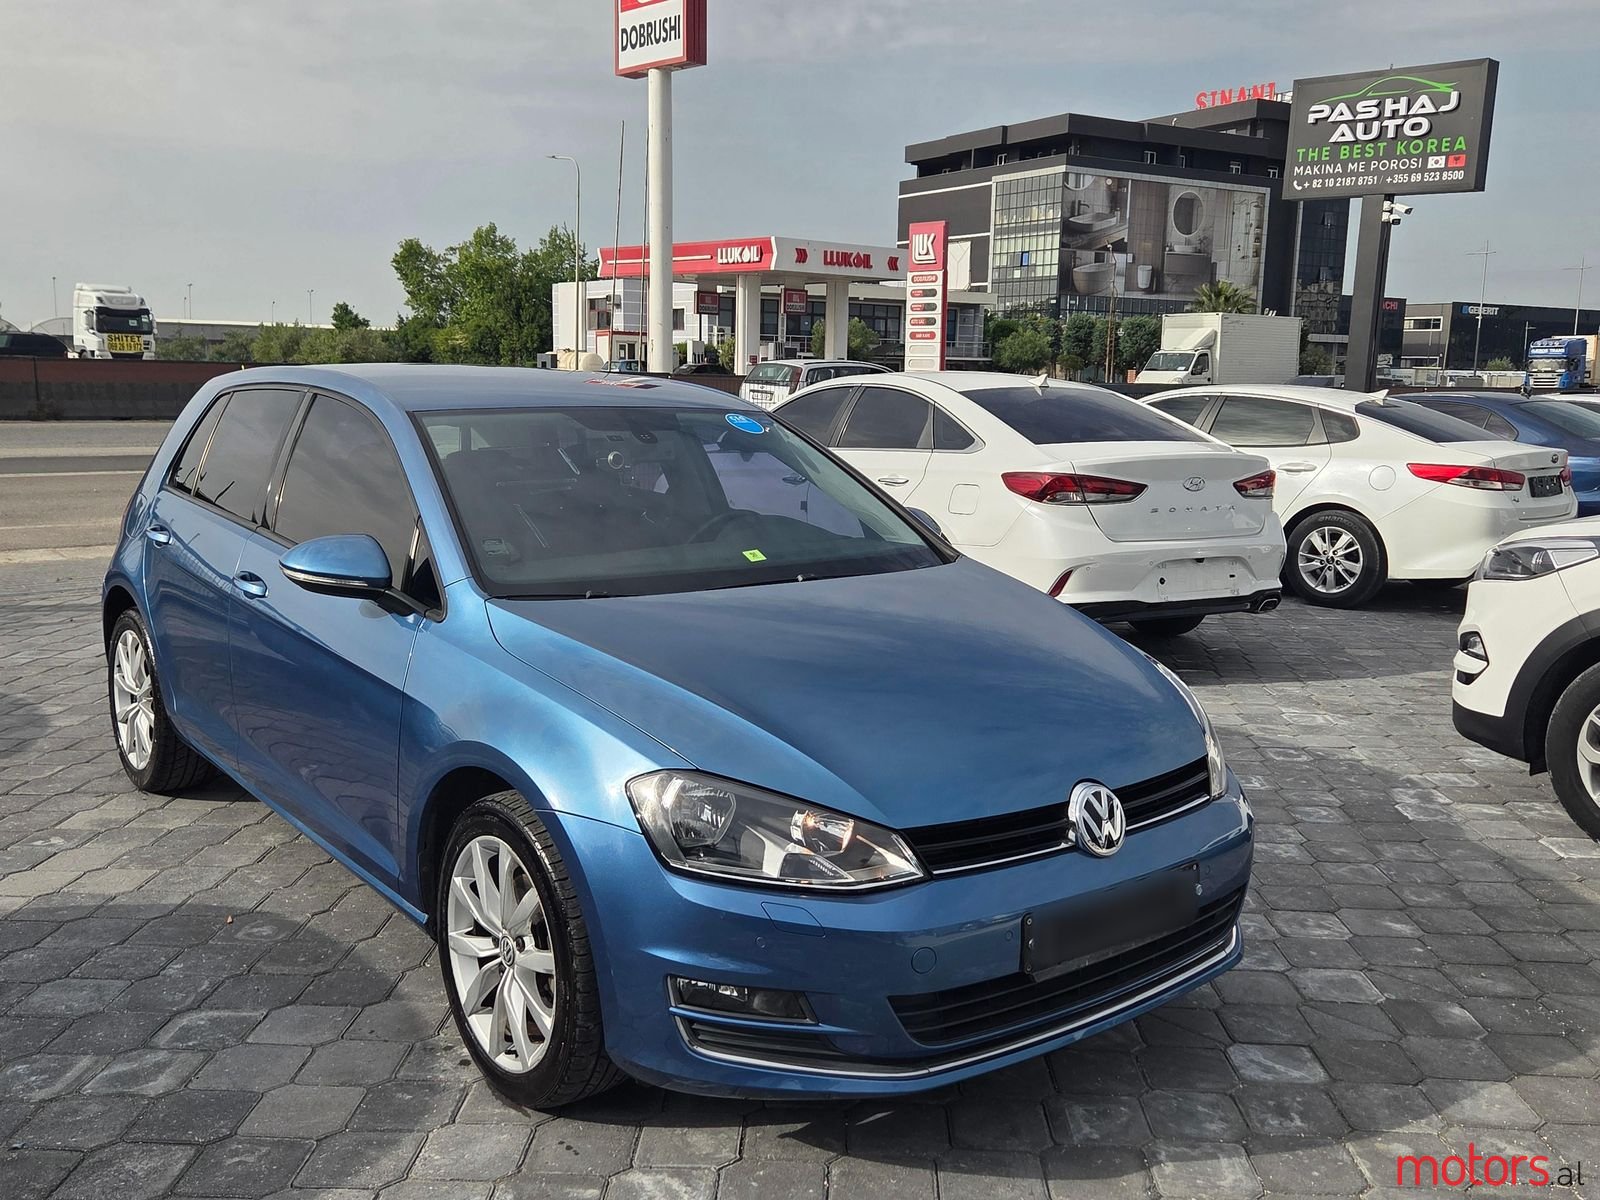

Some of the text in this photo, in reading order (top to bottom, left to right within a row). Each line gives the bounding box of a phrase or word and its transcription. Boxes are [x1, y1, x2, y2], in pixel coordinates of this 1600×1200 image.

[620, 14, 681, 52] DOBRUSHI
[1196, 82, 1275, 109] SINANI
[1307, 91, 1460, 124] PASHAJ
[1328, 116, 1431, 143] AUTO
[1296, 136, 1467, 162] THE BEST KOREA
[1294, 157, 1422, 176] MAKINA ME POROSI
[1325, 178, 1334, 187] 10
[1335, 177, 1356, 187] 2187
[1357, 175, 1377, 186] 8751
[1386, 173, 1409, 184] +355
[1410, 172, 1421, 183] 69
[1423, 171, 1440, 182] 523
[1442, 170, 1465, 181] 8500
[107, 334, 142, 343] SHITET
[1150, 505, 1236, 513] SONATA
